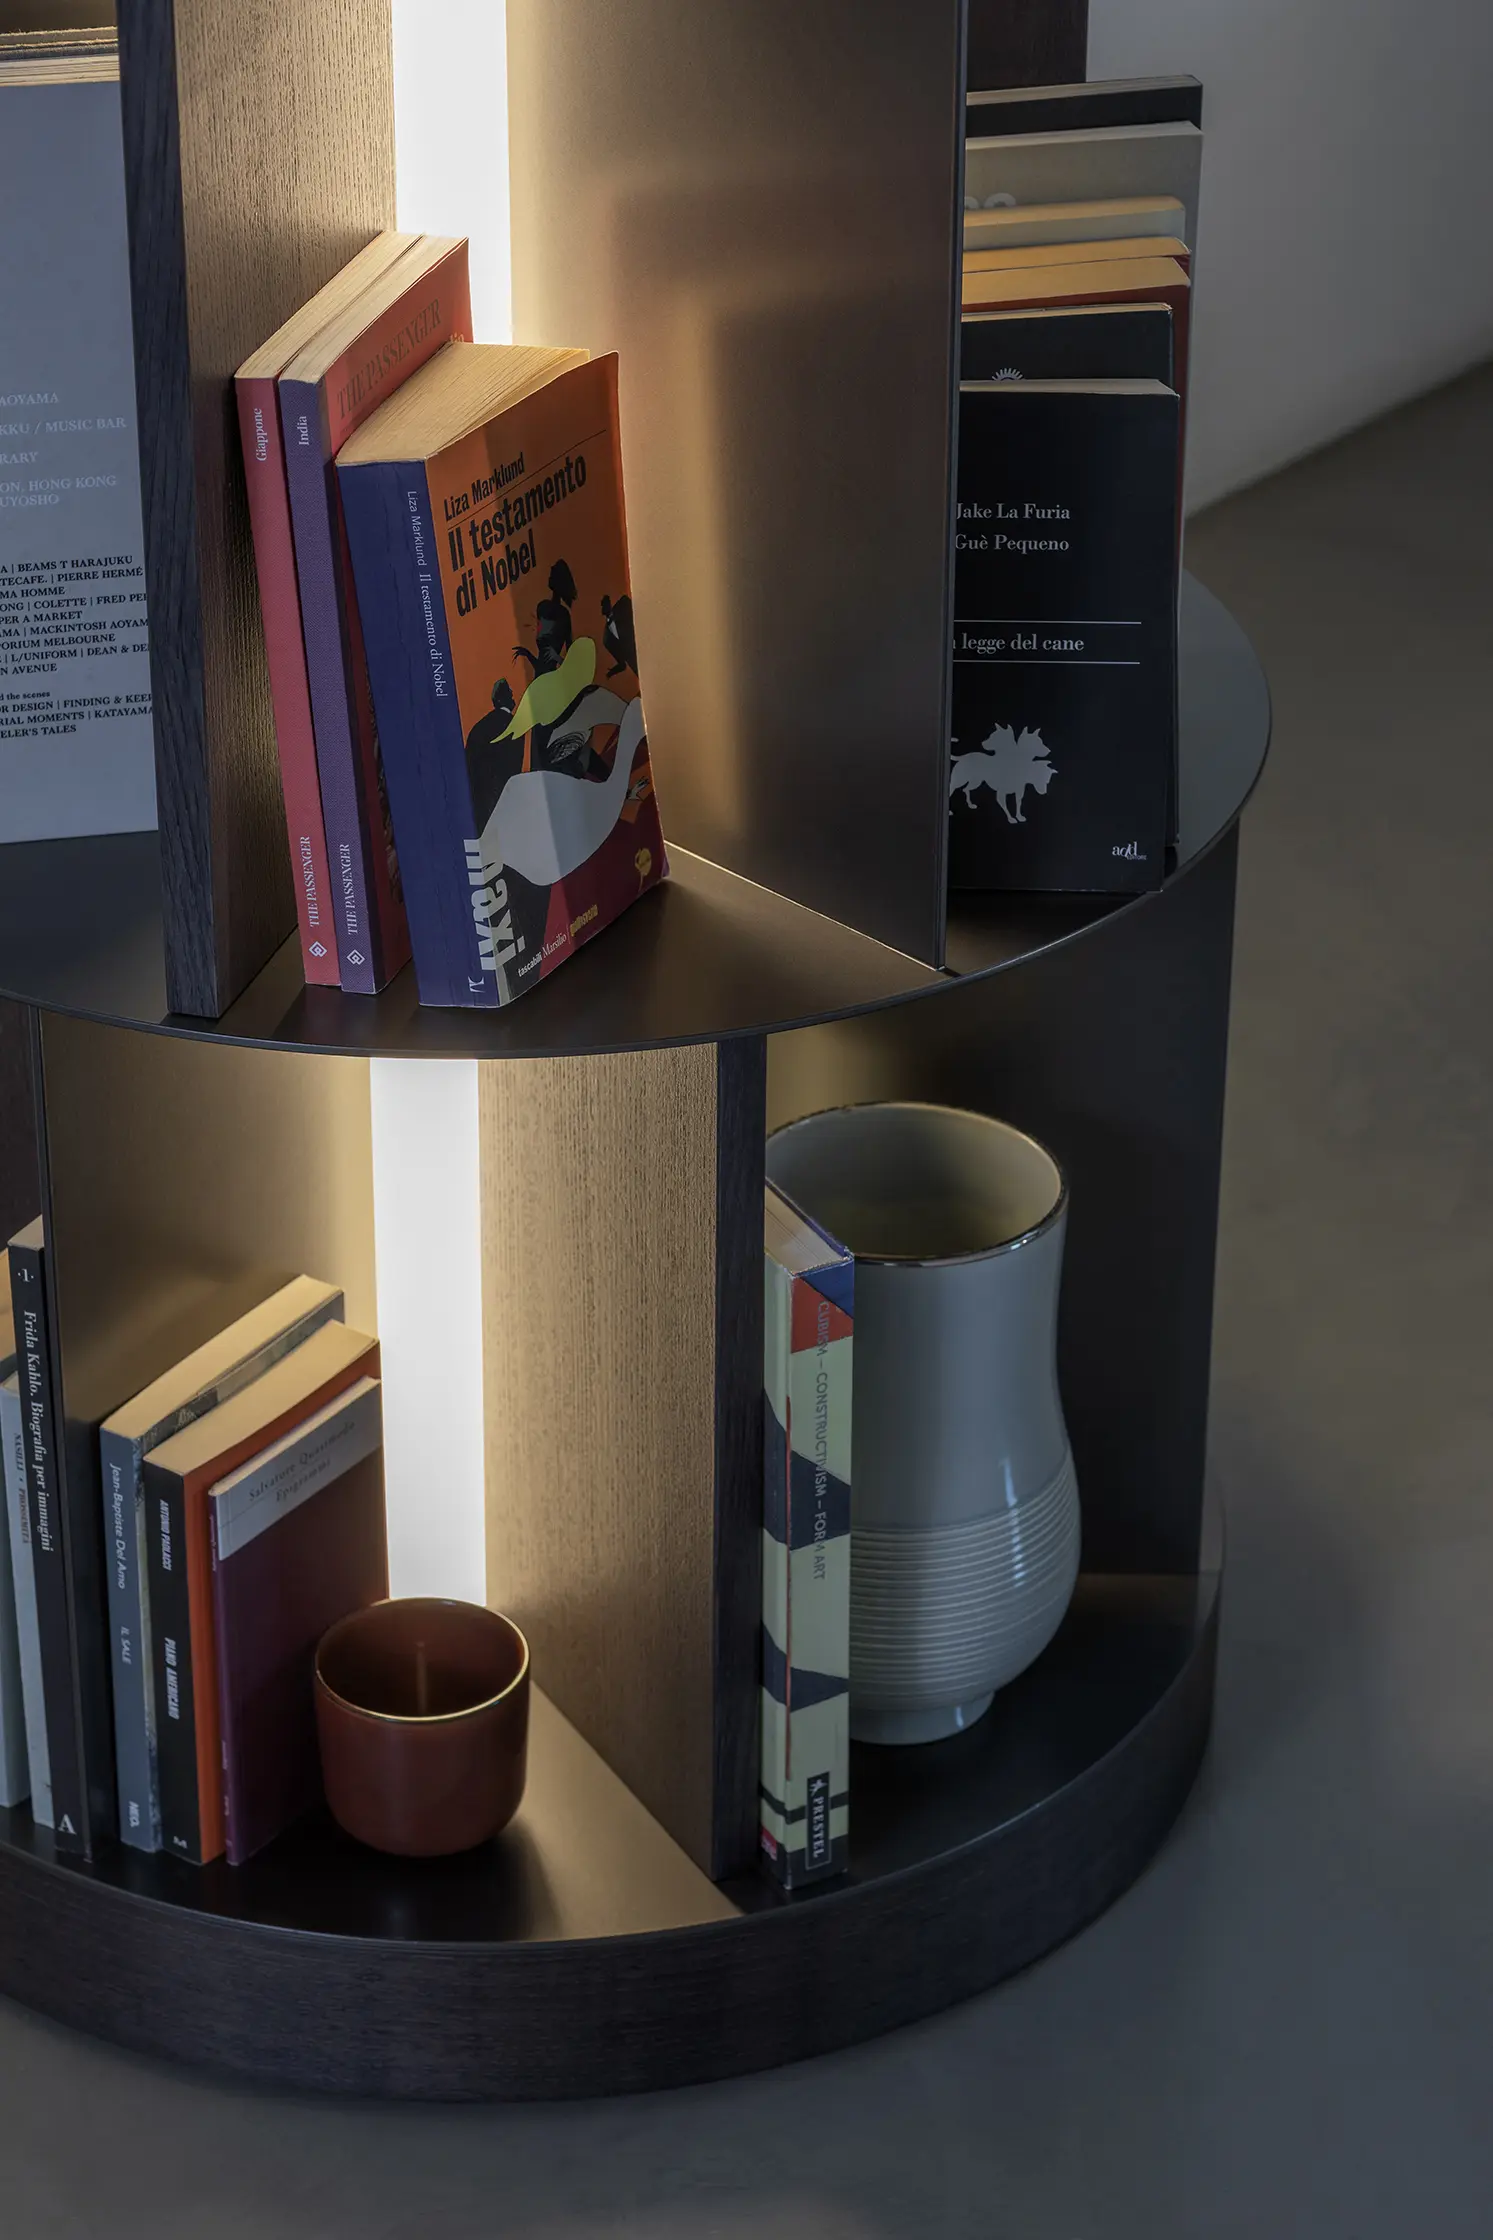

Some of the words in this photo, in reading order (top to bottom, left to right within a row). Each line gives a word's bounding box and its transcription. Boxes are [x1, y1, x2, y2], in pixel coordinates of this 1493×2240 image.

[366, 298, 442, 391] PASSENGER
[45, 419, 93, 433] MUSIC
[97, 416, 127, 430] BAR
[253, 407, 269, 462] Giappone
[296, 415, 310, 446] India
[29, 478, 71, 492] HONG
[75, 475, 117, 489] KONG
[444, 494, 469, 522] Liza
[471, 452, 526, 505] Marklund
[407, 490, 418, 513] Liza
[447, 525, 466, 572] Il
[469, 455, 587, 559] testamento
[956, 502, 992, 520] Jake
[996, 503, 1018, 519] La
[1023, 503, 1071, 520] Furia
[411, 515, 428, 567] Marklund
[955, 534, 988, 550] Guè
[994, 534, 1070, 555] Pequeno
[17, 561, 57, 573] BEAMS
[60, 560, 68, 570] T
[71, 555, 133, 569] HARAJUKU
[57, 573, 99, 583] PIERRE
[102, 566, 144, 579] HERMÉ
[456, 568, 478, 618] di
[481, 528, 537, 602] Nobel
[419, 573, 432, 582] Il
[21, 586, 65, 598] HOMME
[34, 597, 87, 609] COLETTE
[96, 594, 126, 605] FRED
[23, 614, 31, 624] A
[34, 610, 83, 622] MARKET
[421, 585, 438, 647] testamento
[0, 628, 20, 637] MA
[30, 622, 106, 636] MACKINTOSH
[0, 639, 40, 650] ORIUM
[44, 633, 116, 647] MELBOURNE
[11, 647, 78, 663] L/UNIFORM
[87, 645, 117, 656] DEAN
[121, 644, 129, 654] &
[132, 643, 149, 653] DE
[430, 648, 443, 661] di
[962, 632, 1006, 655] legge
[1010, 633, 1038, 650] del
[1042, 637, 1085, 651] cane
[12, 663, 57, 675] AVENUE
[432, 663, 448, 698] Nobel
[7, 692, 20, 701] the
[22, 691, 51, 699] scenes
[12, 701, 53, 713] DESIGN
[64, 696, 110, 708] FINDING
[114, 695, 122, 704] &
[27, 710, 85, 724] MOMENTS
[41, 724, 77, 736] TALES
[300, 836, 318, 902] PASSENGER
[340, 844, 357, 910] PASSENGER
[308, 904, 320, 928] THE
[346, 911, 358, 935] THE
[517, 951, 543, 978] tascabili
[542, 931, 568, 959] Marsilio
[24, 1309, 37, 1349] Frida
[817, 1300, 829, 1357] CUBISM
[27, 1352, 40, 1397] Kahlo.
[29, 1400, 44, 1462] Biografia
[815, 1372, 829, 1498] CONSTRUCTIVISM
[32, 1463, 46, 1490] per
[109, 1463, 125, 1538] Jean-Baptiste
[37, 1490, 54, 1553] immagini
[115, 1539, 126, 1562] Del
[118, 1563, 128, 1590] Amo
[813, 1555, 825, 1581] ART
[121, 1638, 132, 1665] SALE
[164, 1637, 177, 1666] PIANO
[165, 1667, 180, 1720] AMERICANO
[57, 1813, 76, 1835] A
[813, 1795, 824, 1859] PRESTEL
